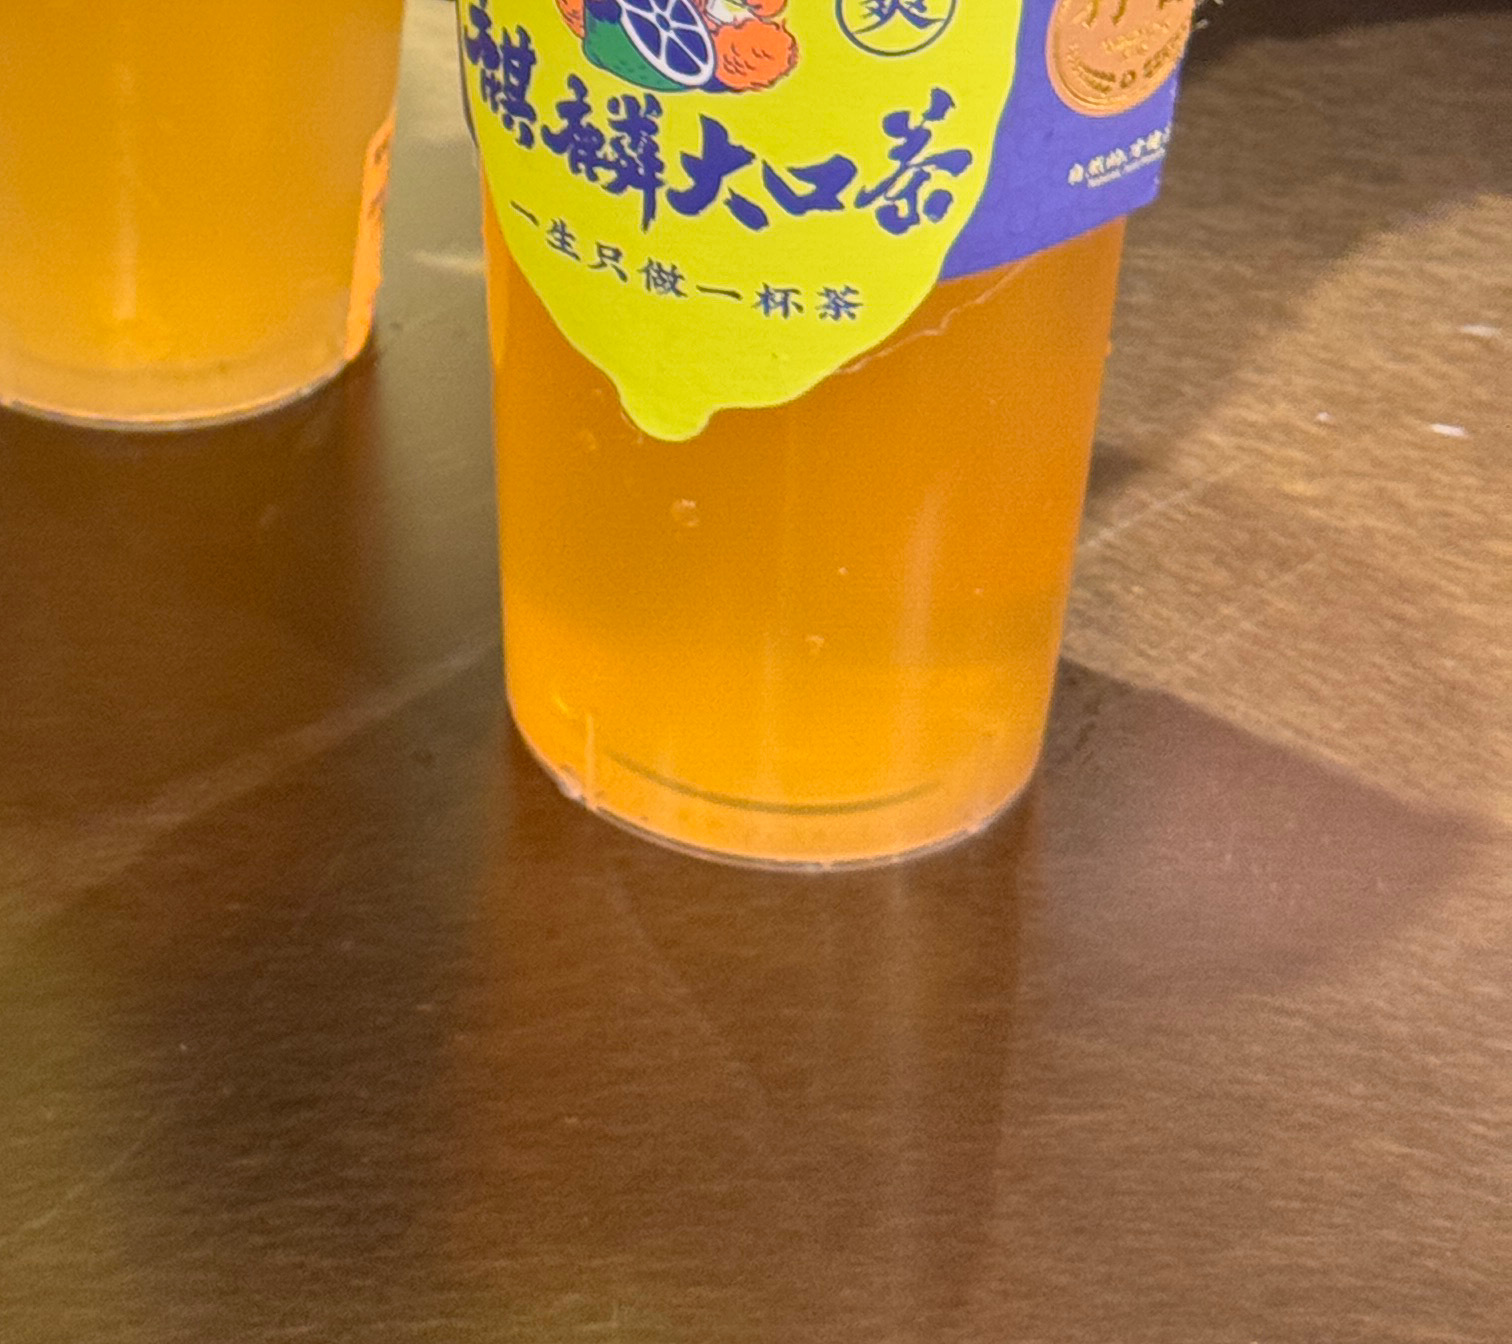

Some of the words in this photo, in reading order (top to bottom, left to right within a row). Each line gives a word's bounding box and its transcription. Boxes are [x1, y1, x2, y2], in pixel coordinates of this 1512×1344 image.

[509, 199, 864, 322] 一生只做一杯茶
